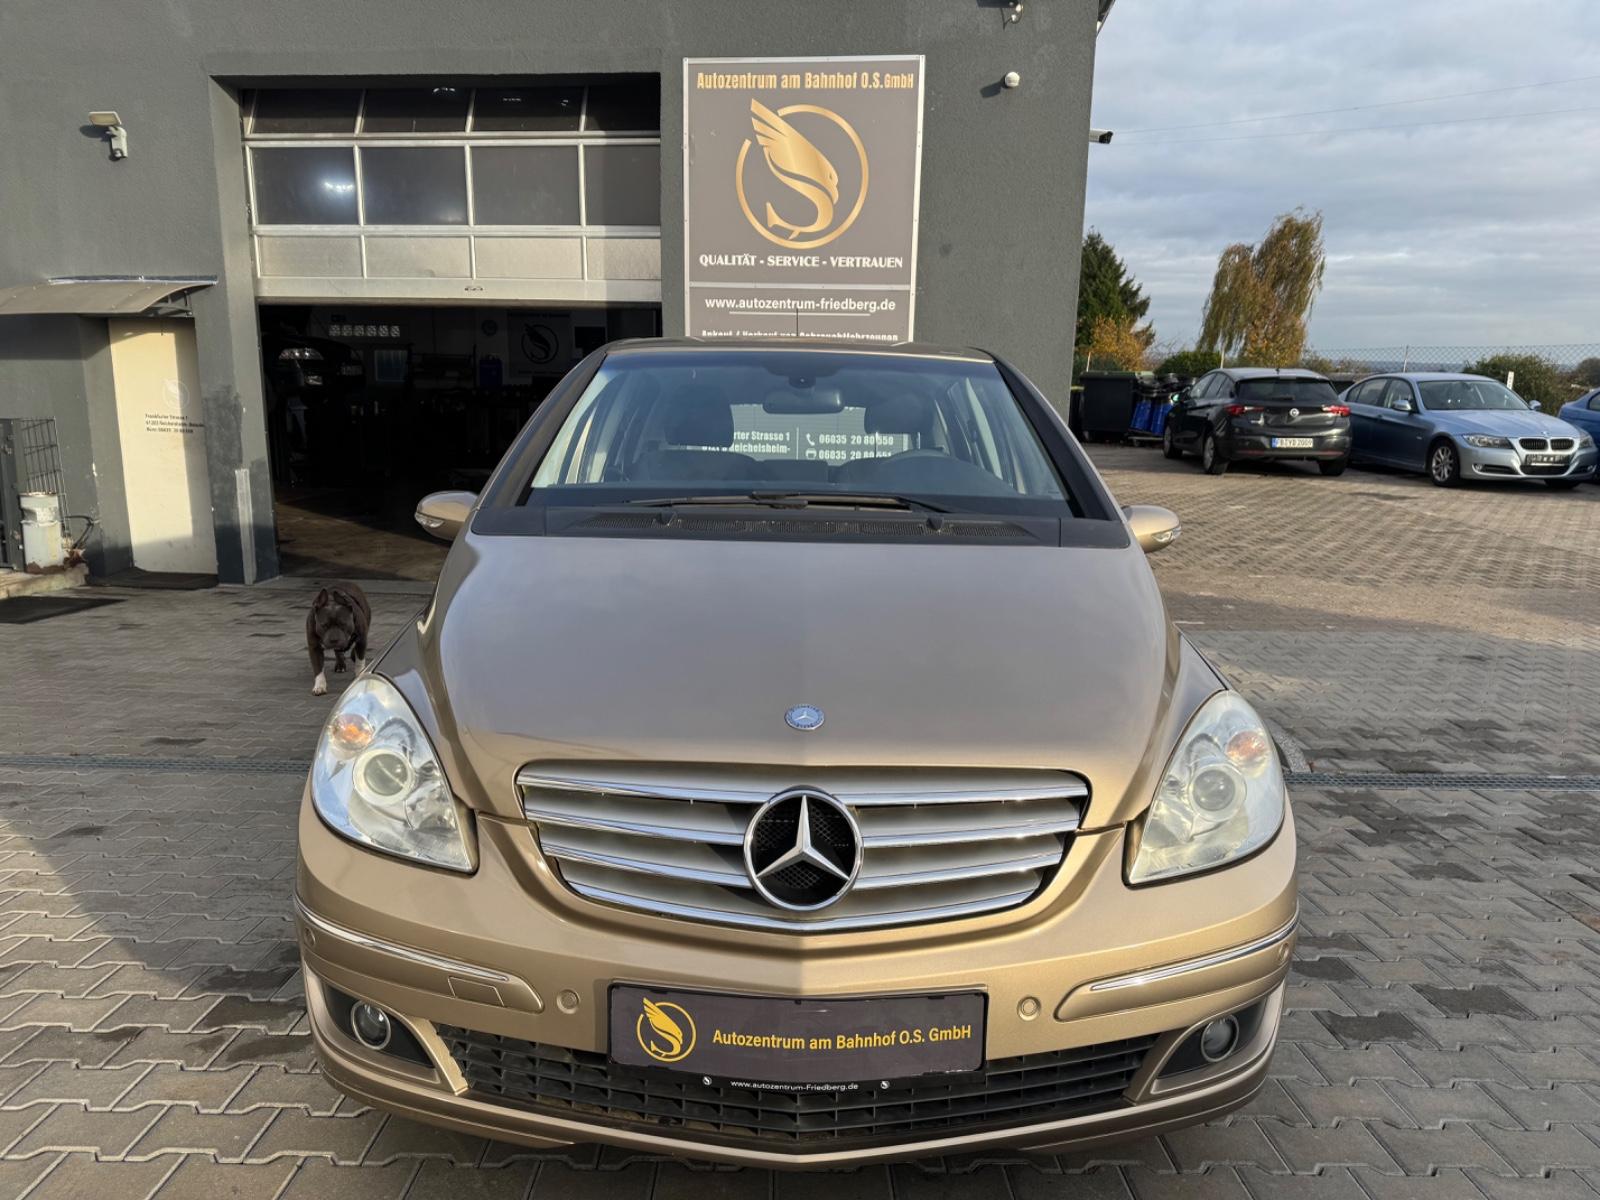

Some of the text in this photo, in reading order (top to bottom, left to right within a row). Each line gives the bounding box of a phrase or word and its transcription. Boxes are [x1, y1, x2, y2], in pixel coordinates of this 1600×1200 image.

[697, 72, 777, 89] Autozentrum
[781, 74, 801, 89] am
[804, 72, 857, 89] Bahnhof
[699, 253, 757, 268] QUALITÄT
[767, 255, 820, 268] SERVICE
[830, 256, 903, 269] VERTRAUEN
[704, 297, 896, 313] www.autozentrum-friedberg.de
[751, 431, 784, 441] Strasse
[786, 432, 790, 441] 1
[851, 435, 861, 445] 20
[712, 1025, 972, 1050] Autozentrum am Bahnhof O.S. GmbH
